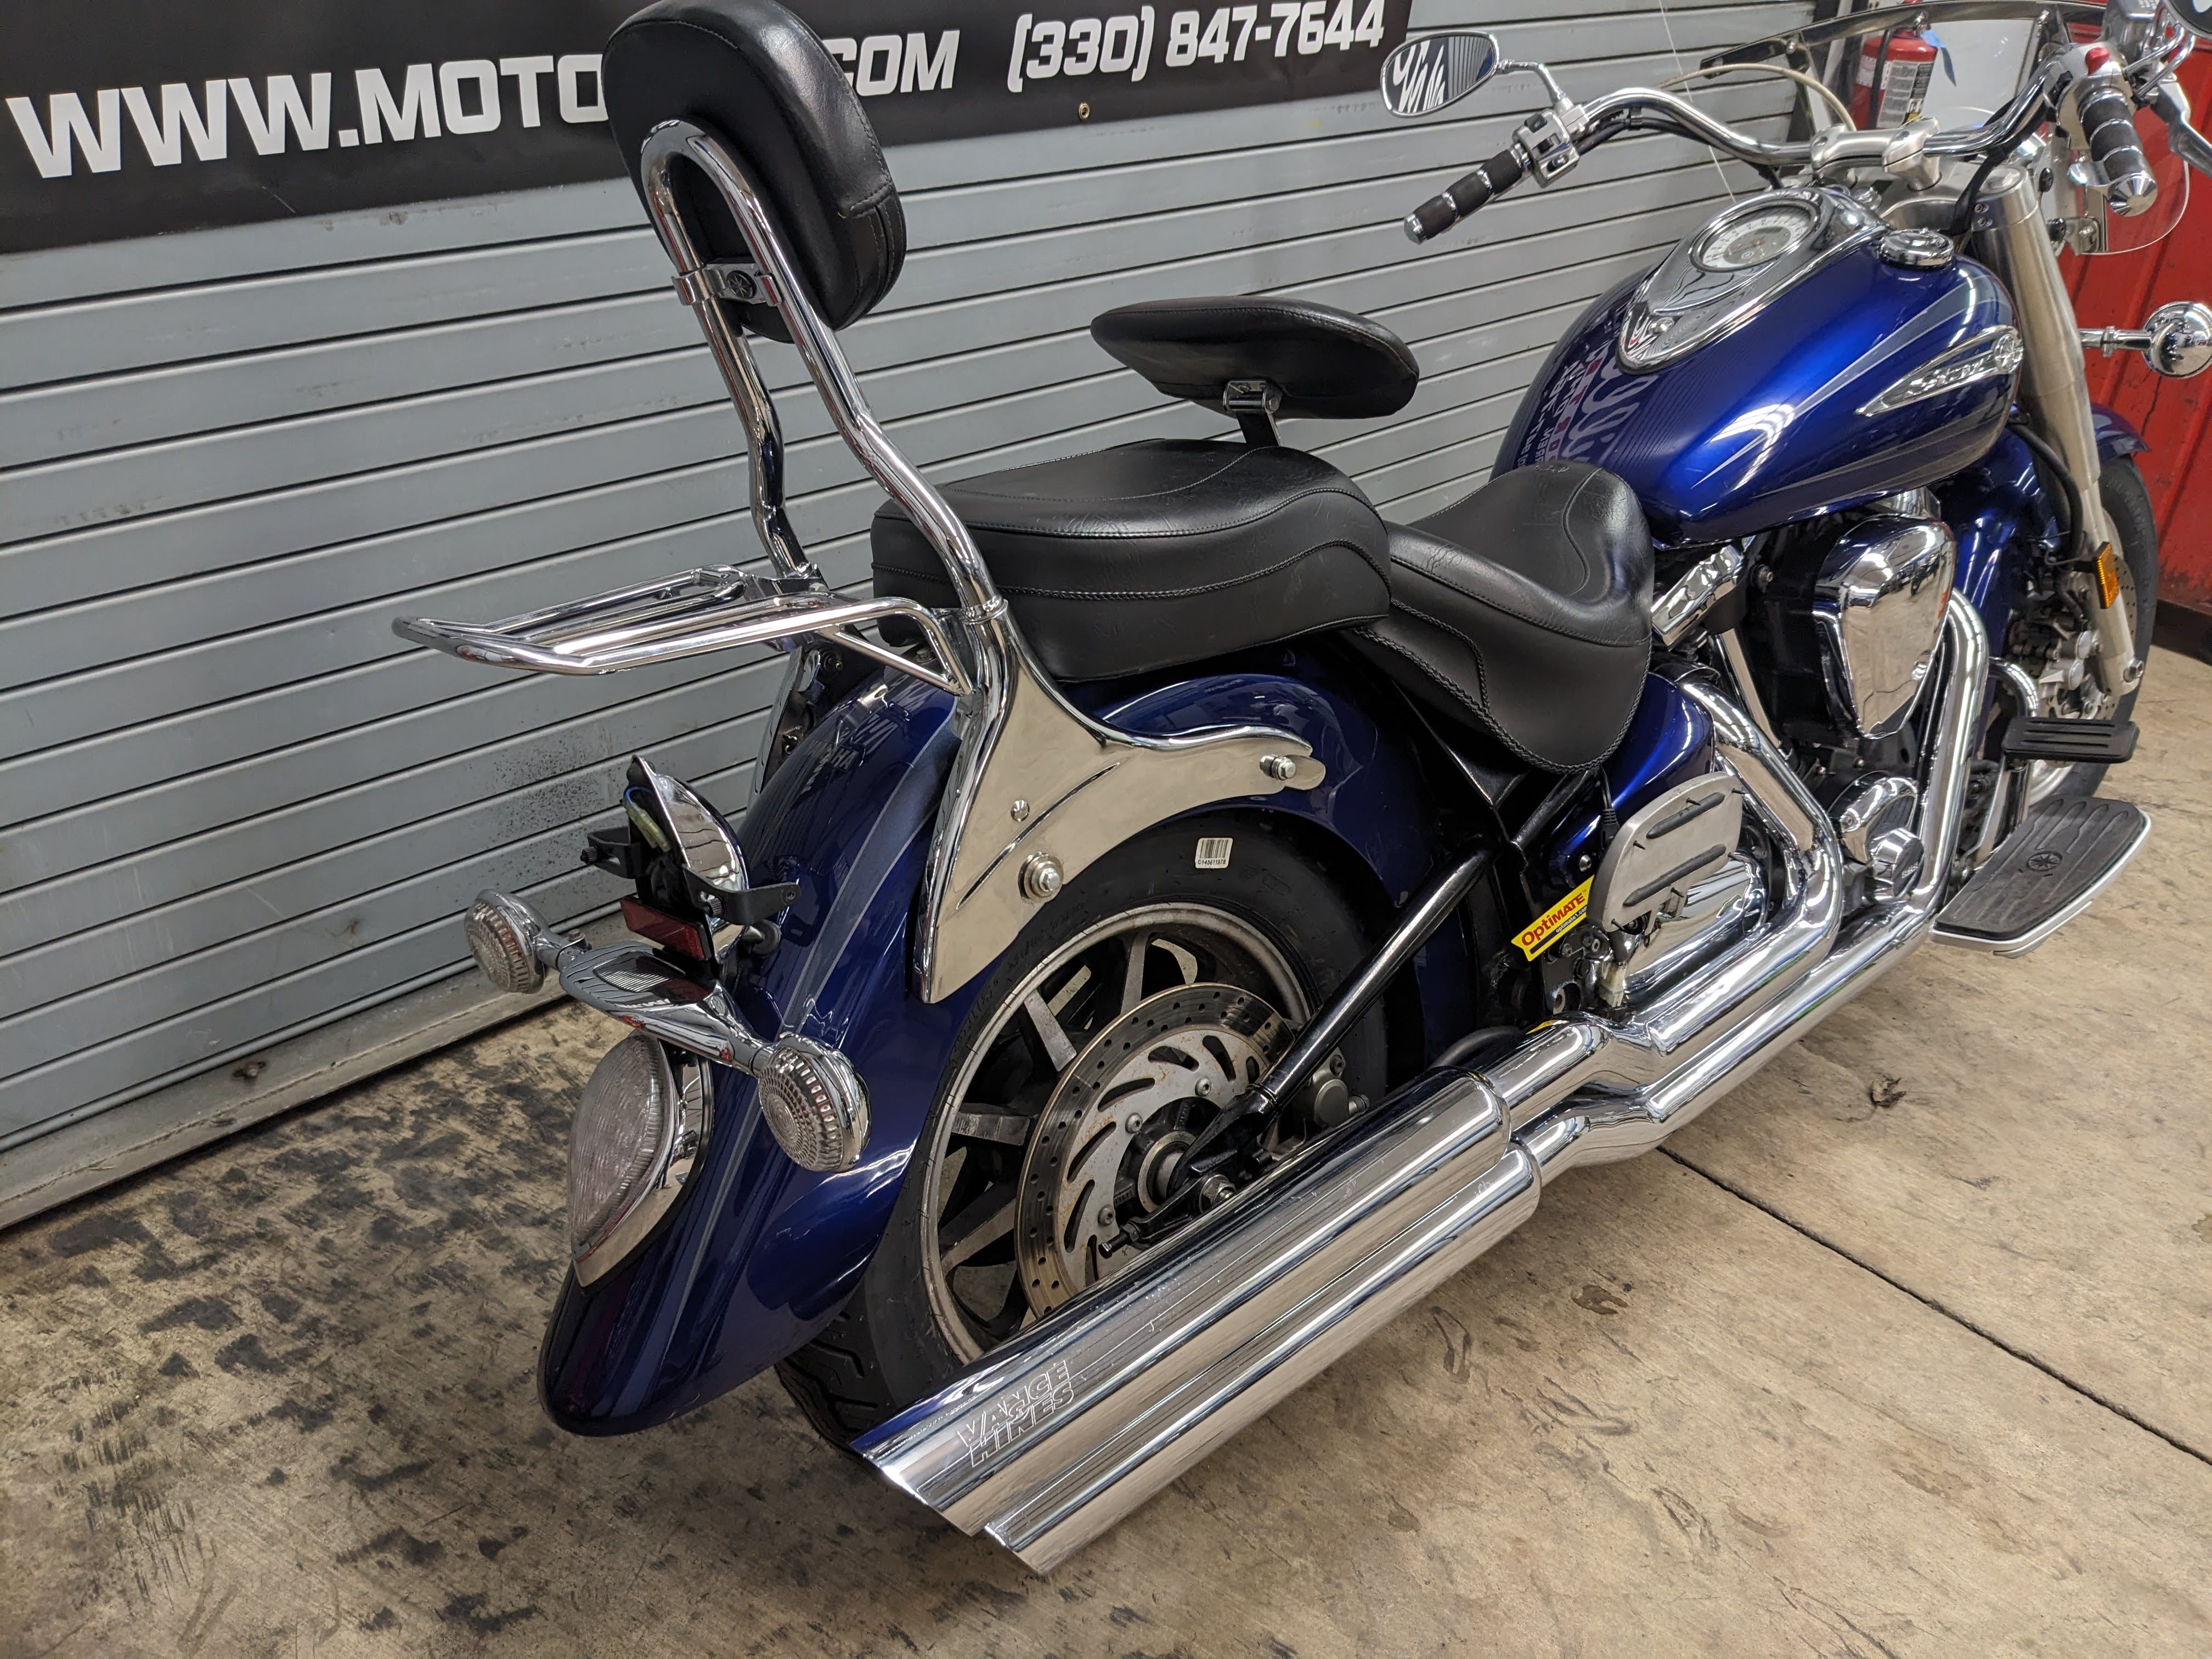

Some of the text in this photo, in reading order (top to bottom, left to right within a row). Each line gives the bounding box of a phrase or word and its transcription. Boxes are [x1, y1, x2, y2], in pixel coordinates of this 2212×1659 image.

[1007, 5, 1154, 92] (330)
[1165, 0, 1385, 67] 847-7644
[1521, 892, 1585, 946] OptiMATE
